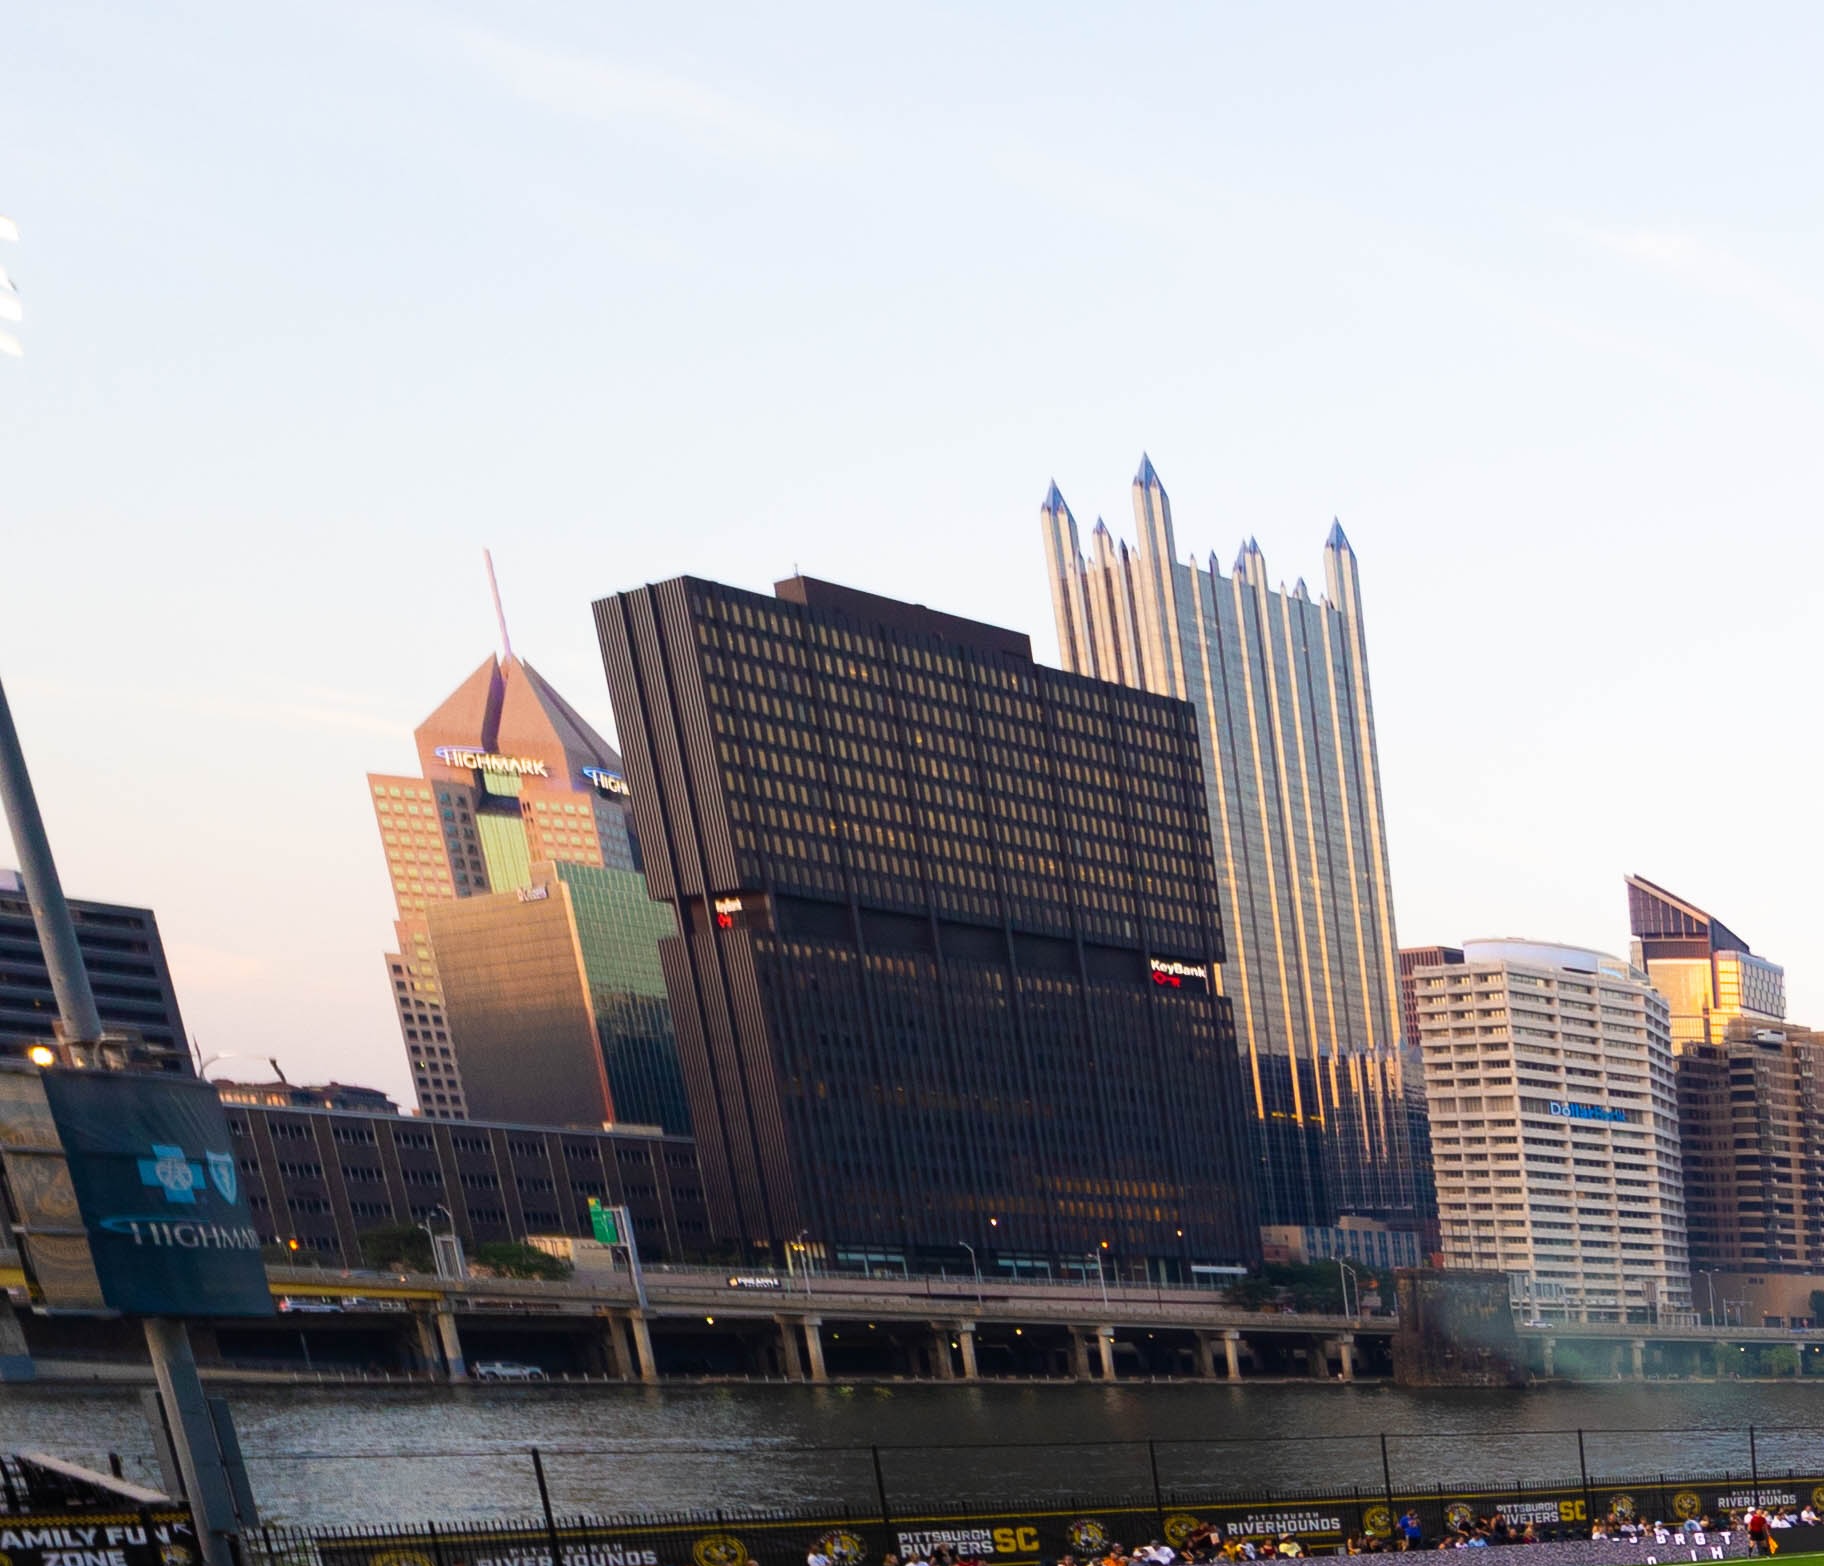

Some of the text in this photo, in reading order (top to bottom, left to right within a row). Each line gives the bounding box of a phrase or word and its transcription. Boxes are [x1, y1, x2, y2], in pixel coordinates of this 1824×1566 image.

[440, 748, 549, 778] HIGHMARK
[1247, 1512, 1319, 1524] PITTSBURGH
[1559, 1500, 1587, 1522] SC
[897, 1528, 992, 1544] PITTSBURGH
[1227, 1518, 1341, 1536] RIVERHOUNDS
[0, 1527, 97, 1550] AMILY
[992, 1526, 1040, 1553] SC
